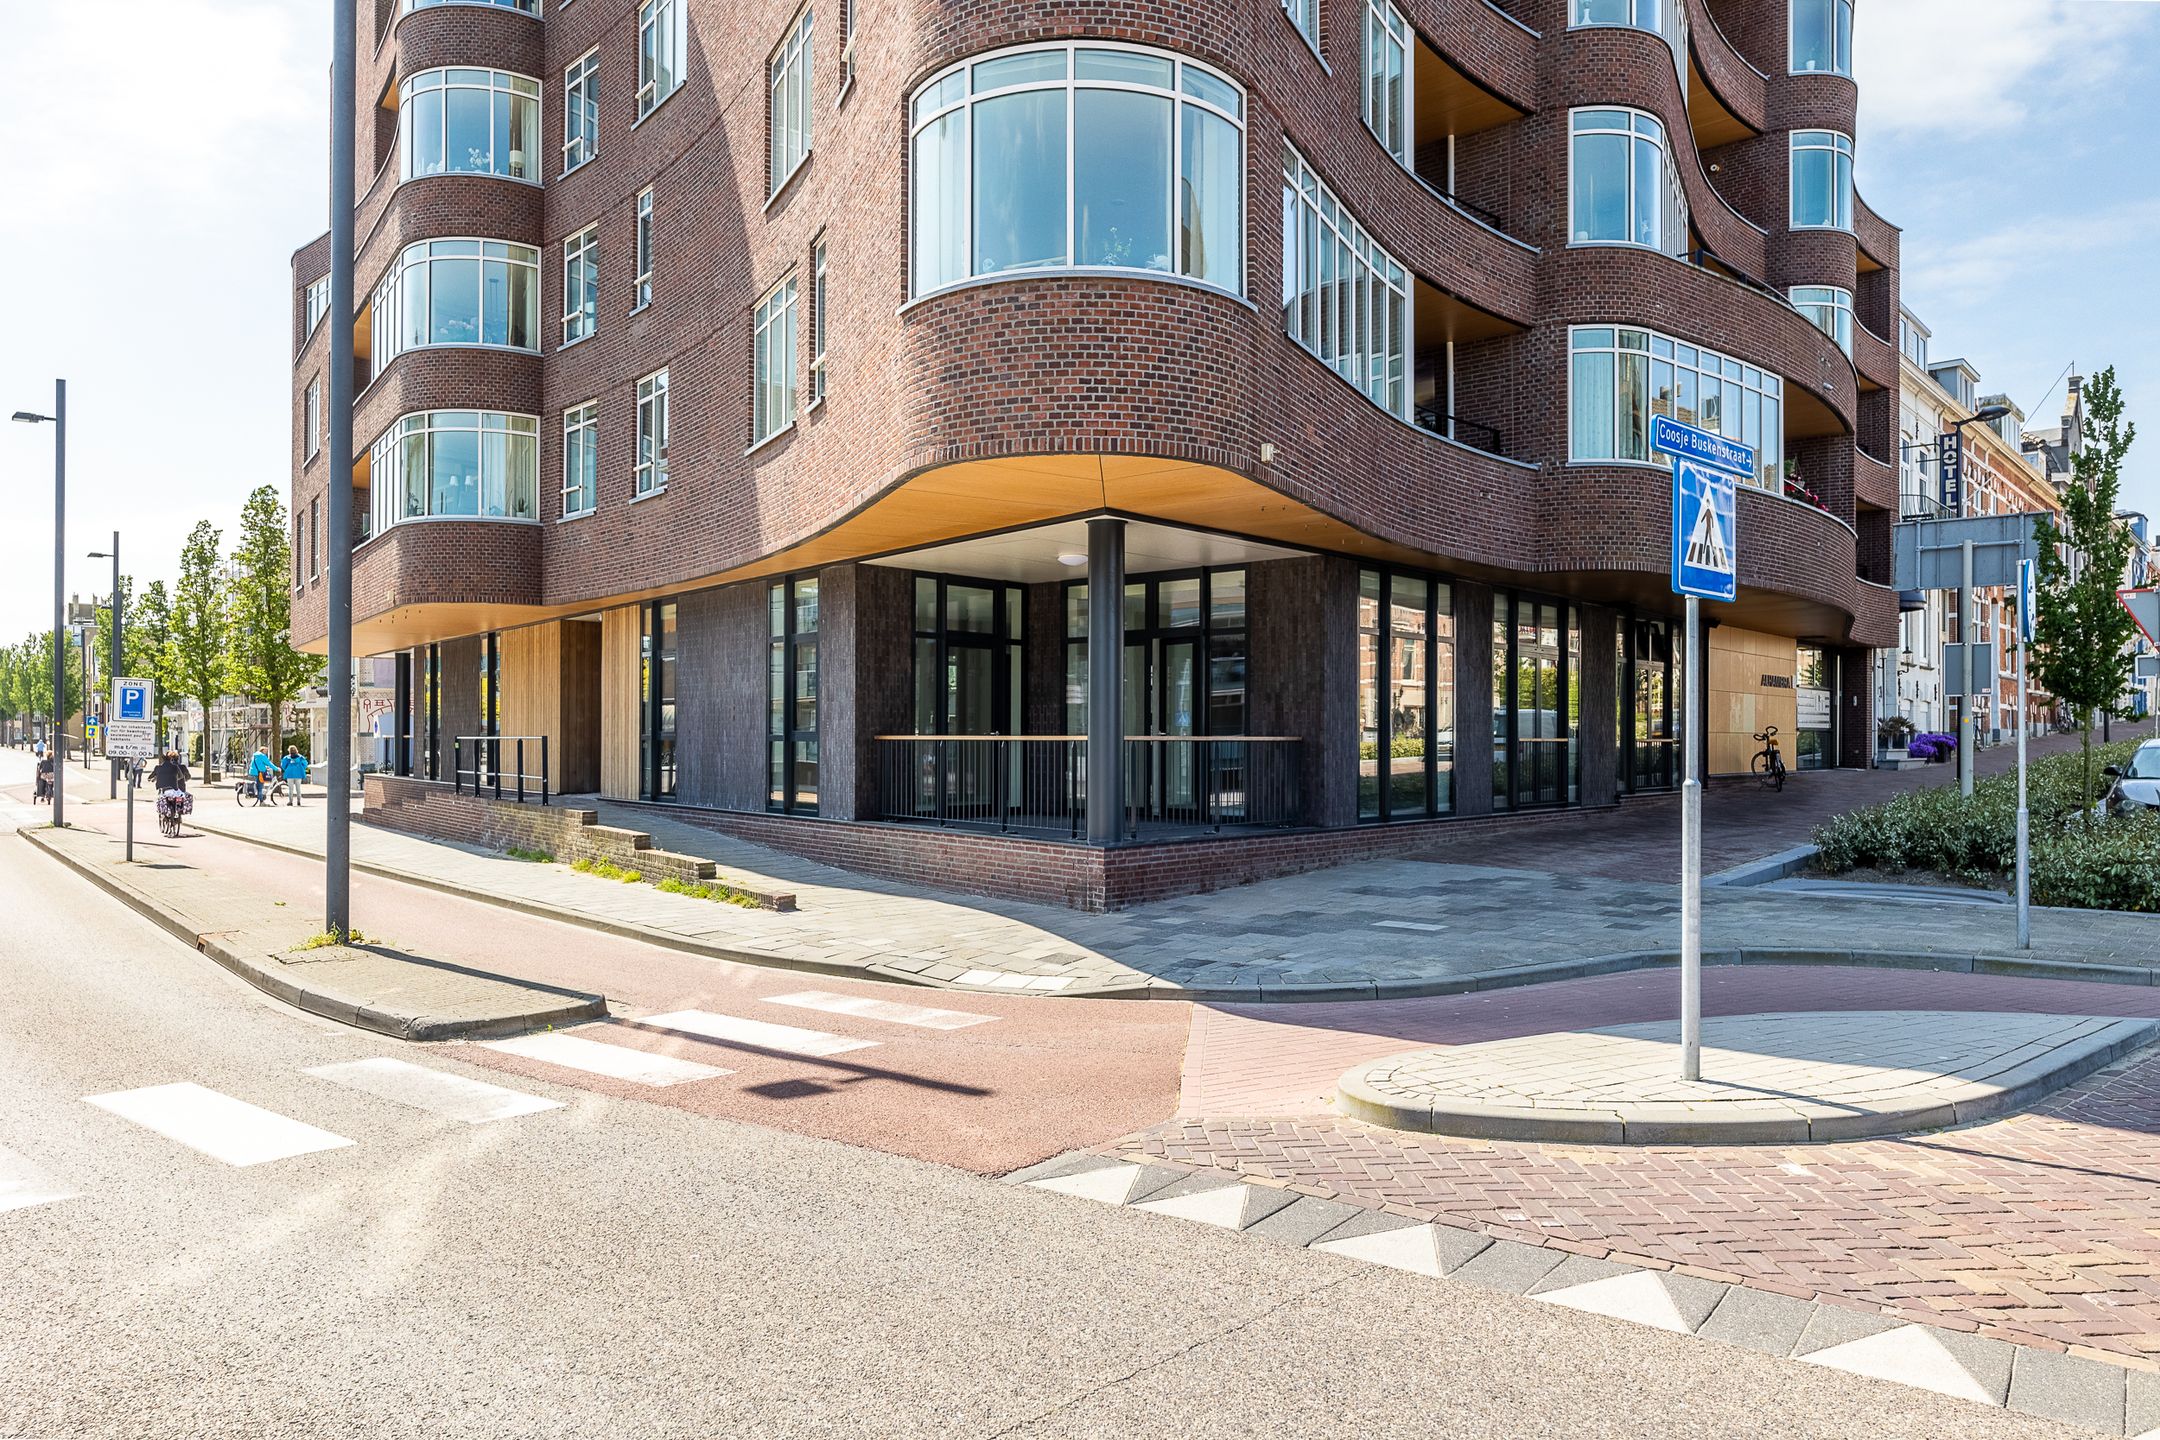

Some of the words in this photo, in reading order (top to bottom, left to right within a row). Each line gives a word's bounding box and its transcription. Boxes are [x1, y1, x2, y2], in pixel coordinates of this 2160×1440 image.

[1660, 423, 1689, 449] Coosje
[1691, 433, 1746, 465] Buskenstraat
[1943, 436, 1957, 506] HOTEL
[126, 689, 140, 705] P
